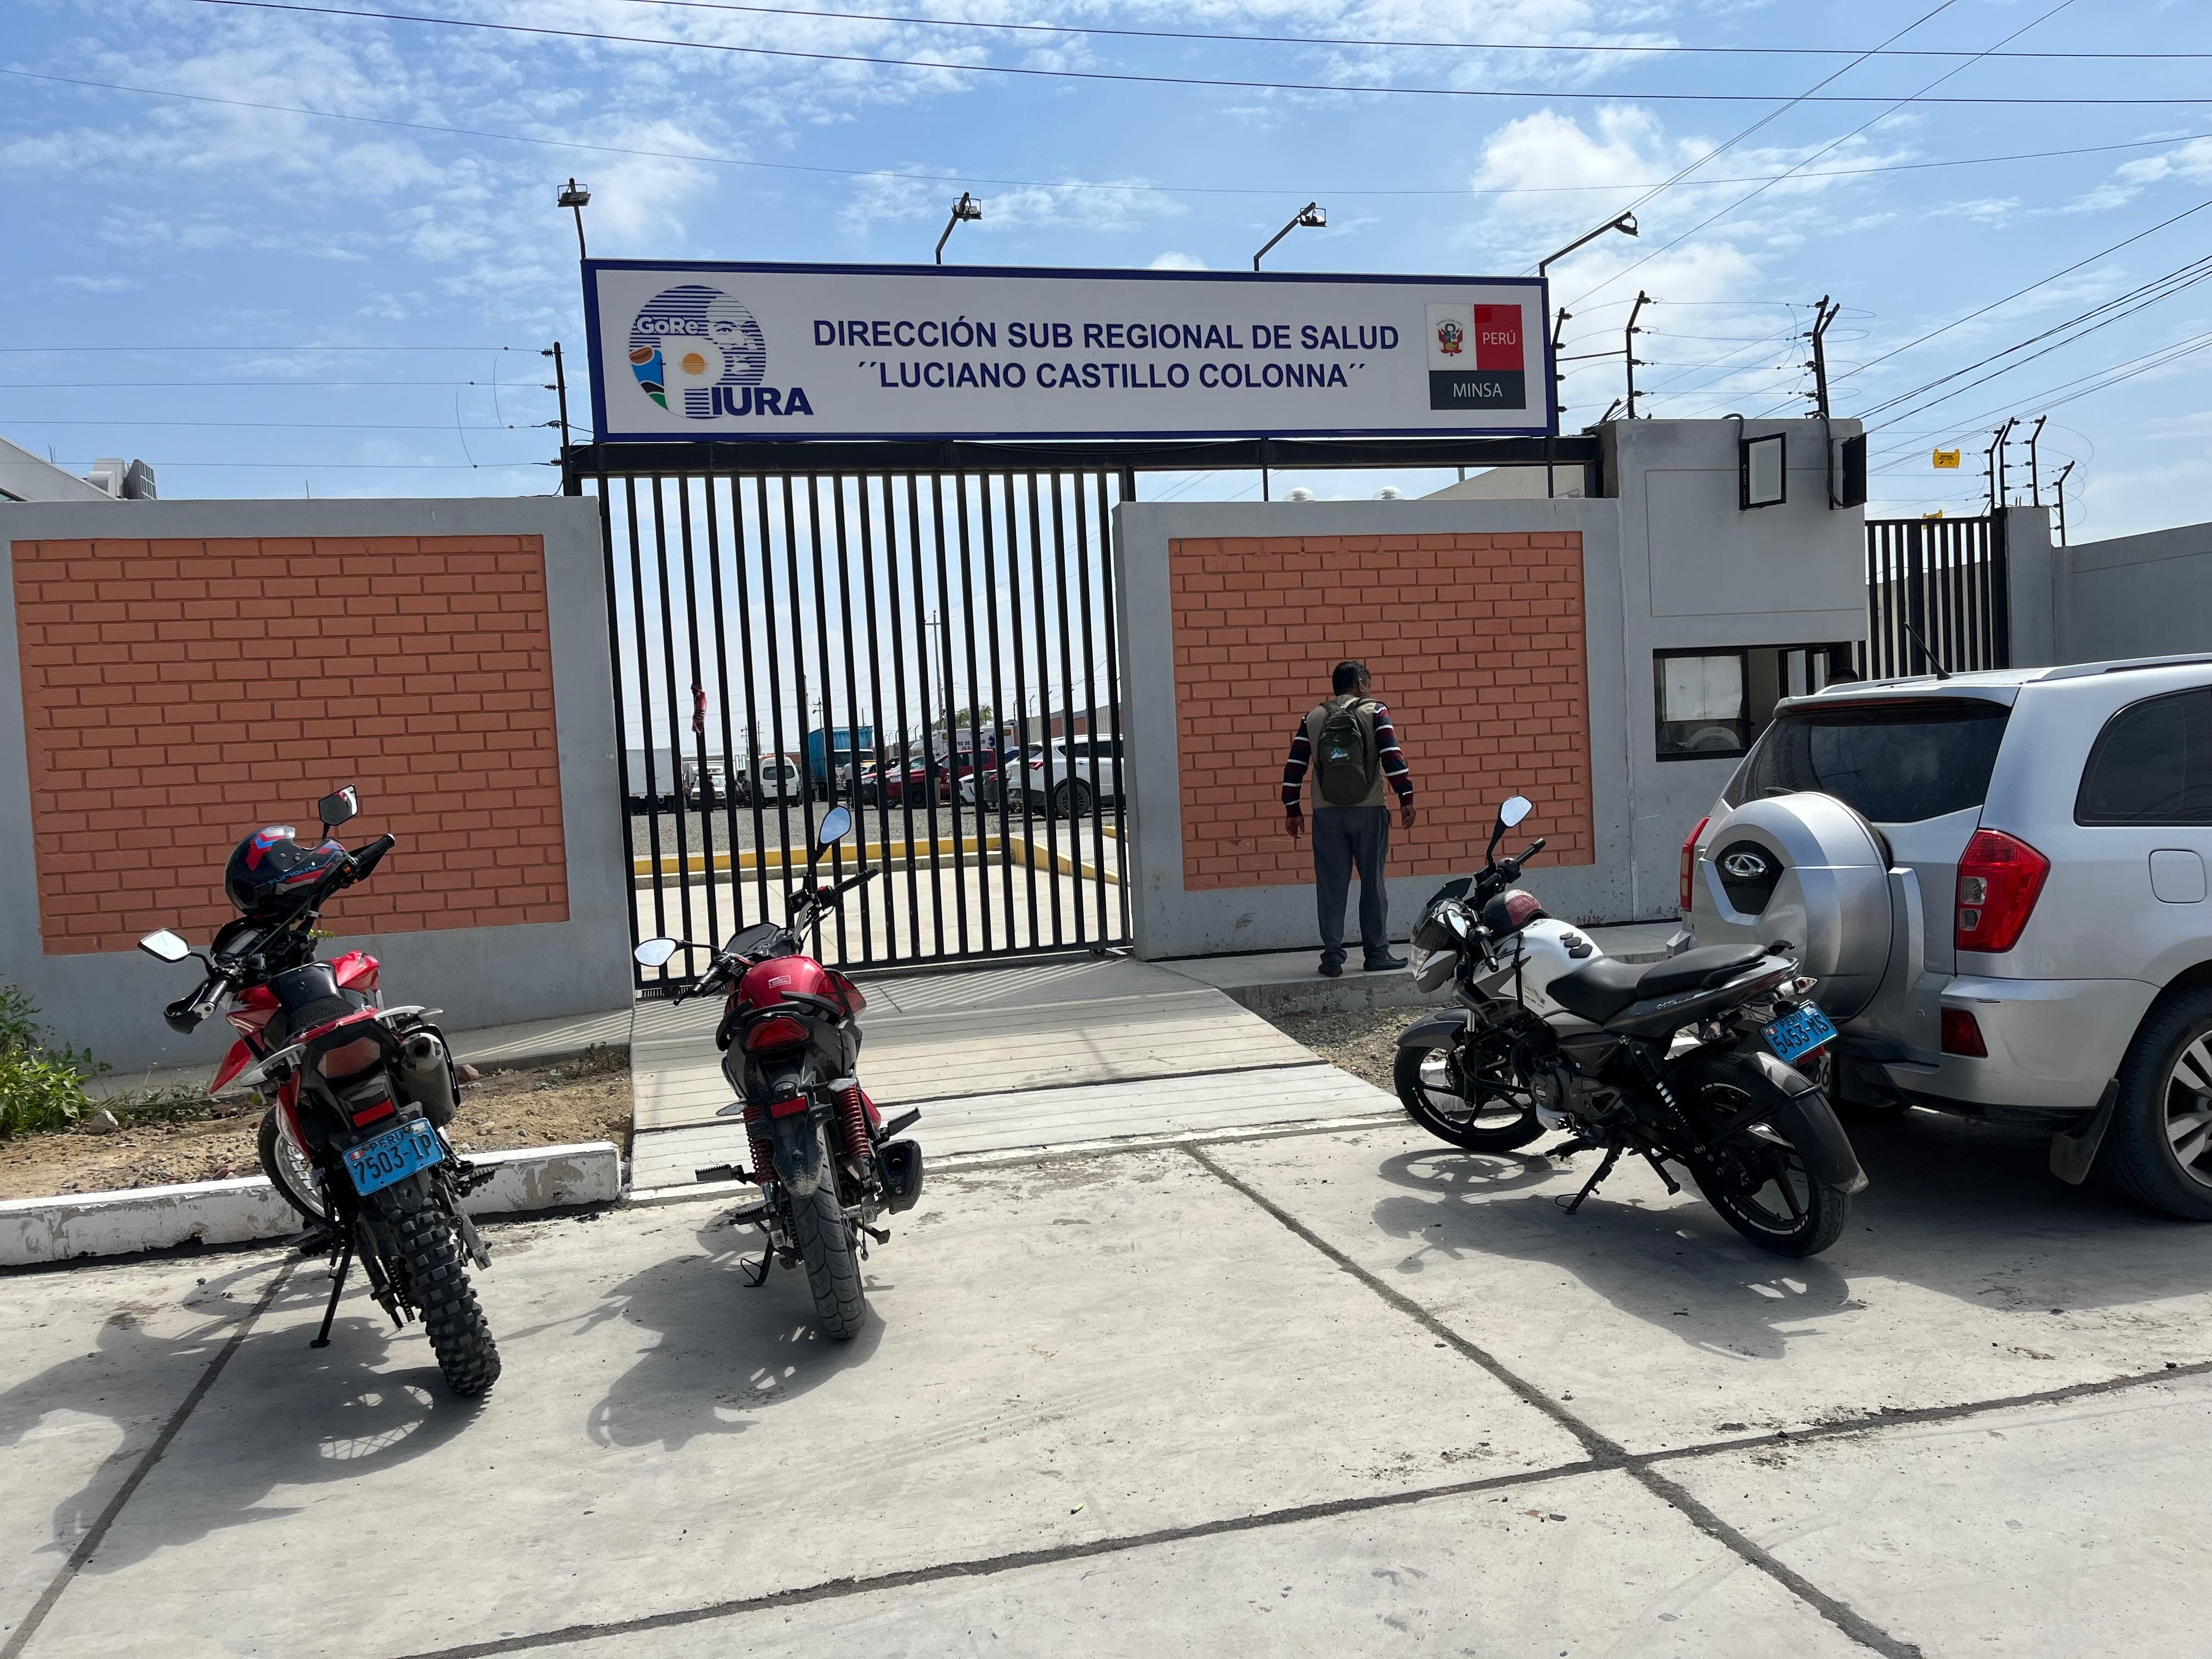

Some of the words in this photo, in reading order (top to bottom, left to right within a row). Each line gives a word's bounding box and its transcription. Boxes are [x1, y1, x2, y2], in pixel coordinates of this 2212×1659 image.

[814, 315, 997, 348] DIRECCIÓN
[1008, 322, 1073, 348] SUB
[1083, 323, 1244, 349] REGIONAL
[1252, 325, 1291, 349] DE
[1301, 325, 1399, 349] SALUD
[1483, 330, 1516, 345] PERÚ
[1036, 363, 1189, 388] CASTILLO
[1453, 382, 1503, 398] MINSA
[369, 1130, 405, 1152] PERU
[353, 1133, 432, 1185] 7503-1P
